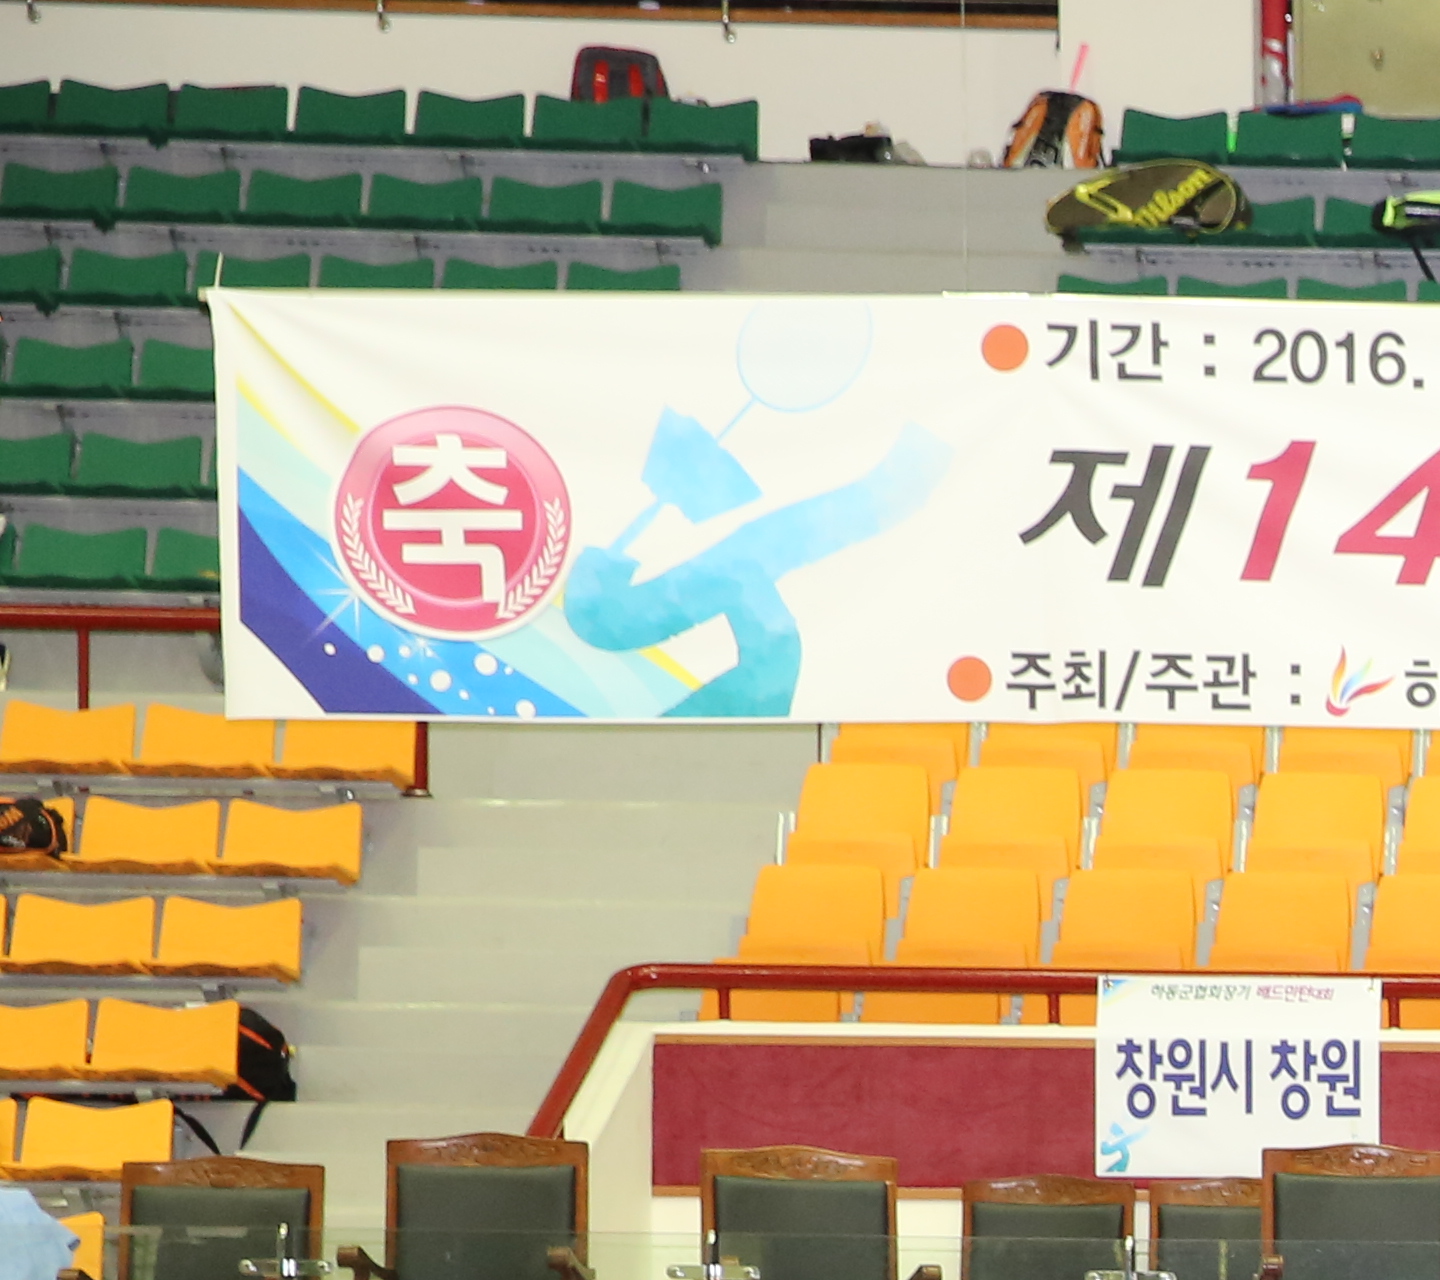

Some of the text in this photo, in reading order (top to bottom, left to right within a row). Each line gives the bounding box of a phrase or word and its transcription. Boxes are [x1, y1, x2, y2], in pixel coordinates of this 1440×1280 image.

[1047, 320, 1168, 381] 기간
[1253, 329, 1423, 388] 2016.
[382, 434, 524, 604] 축
[1007, 651, 1256, 711] 주최/주관
[1150, 982, 1335, 1004] 하동군협회장기 배드민턴대회
[1116, 1038, 1361, 1120] 창원시 창원
